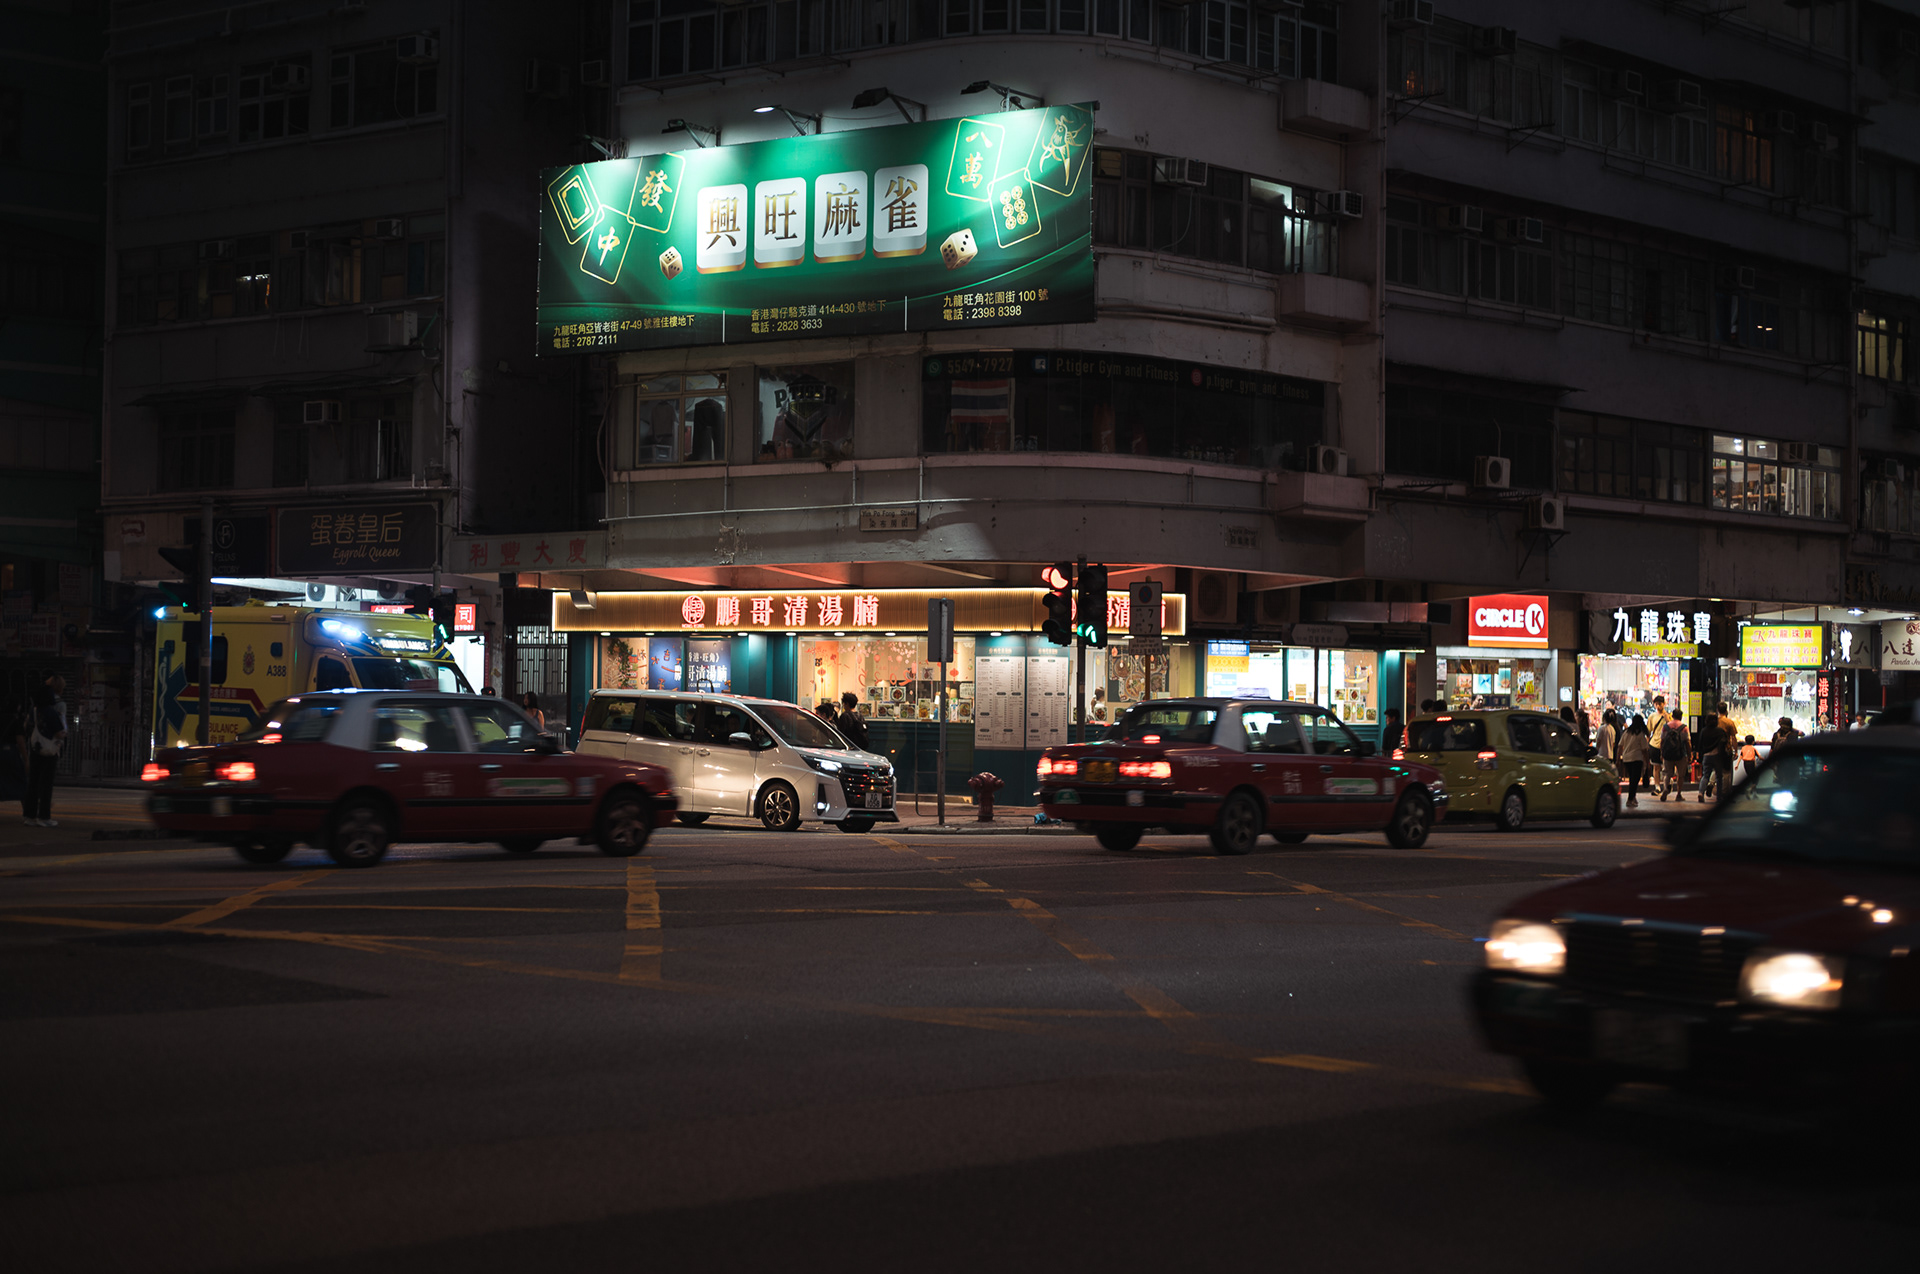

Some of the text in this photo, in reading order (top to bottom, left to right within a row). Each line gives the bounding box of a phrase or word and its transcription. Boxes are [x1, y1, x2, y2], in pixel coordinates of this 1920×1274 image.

[639, 169, 673, 214] 發
[705, 175, 919, 250] 興旺麻雀
[597, 226, 621, 267] 中
[943, 288, 1049, 308] 九龍旺角花園街 100 號
[751, 299, 887, 322] 香港灣仔駱克道 414-430 號地下
[971, 304, 996, 319] 2398
[997, 304, 1022, 318] 8398
[553, 317, 620, 338] 九龍旺角亞皆老街
[620, 318, 643, 331] 47-49
[776, 319, 799, 332] 2828
[800, 317, 823, 330] 3633
[576, 333, 595, 347] 2787
[597, 333, 618, 346] 2111
[983, 356, 1014, 373] 7927
[1056, 357, 1180, 382] P.tiger Gym and Fitness
[882, 509, 896, 518] Fong
[310, 511, 404, 547] 蛋卷皇后
[332, 545, 402, 566] Eggroll Queen
[468, 537, 587, 568] 利豐大廈
[715, 594, 880, 627] 鵬哥清湯腩
[1148, 608, 1154, 619] 7
[1475, 605, 1544, 633] CIRCLE K
[1148, 623, 1154, 634] 7
[1613, 606, 1711, 645] 九龍珠寶
[1883, 637, 1916, 656] 八達
[266, 664, 287, 678] A388
[1645, 660, 1660, 675] BIG
[1890, 657, 1910, 667] Panda
[1648, 675, 1669, 690] SALE
[209, 722, 239, 734] BULANCE
